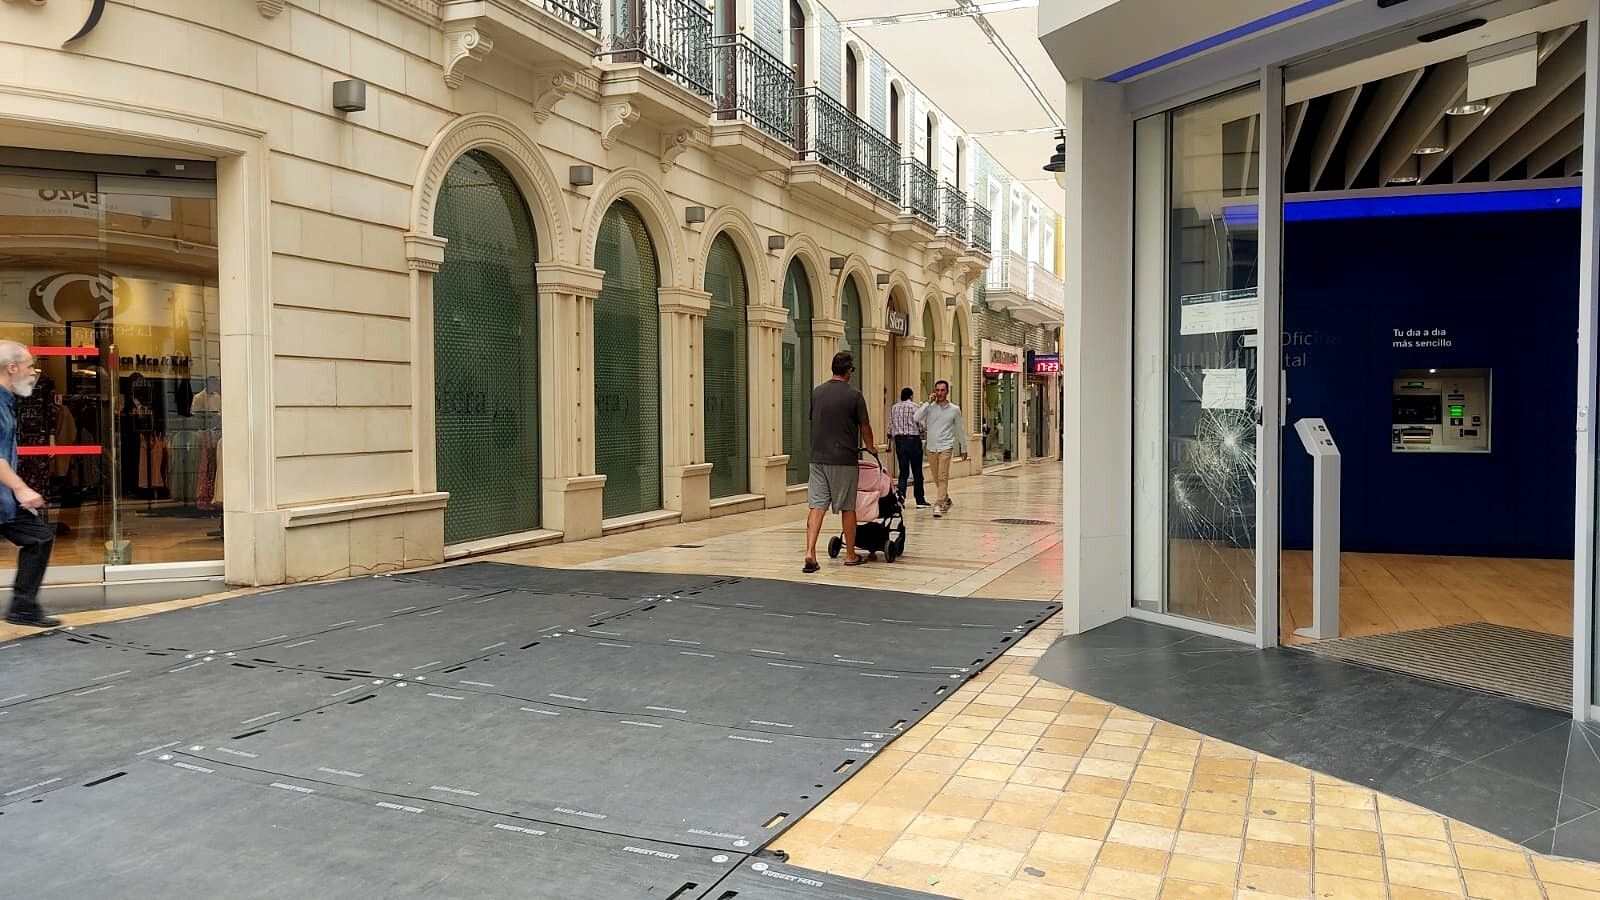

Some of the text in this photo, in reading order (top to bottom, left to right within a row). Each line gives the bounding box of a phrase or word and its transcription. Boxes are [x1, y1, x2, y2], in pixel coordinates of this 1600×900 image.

[1392, 328, 1404, 337] Tu
[1392, 338, 1452, 348] más sencillo
[1037, 362, 1059, 372] 17:23
